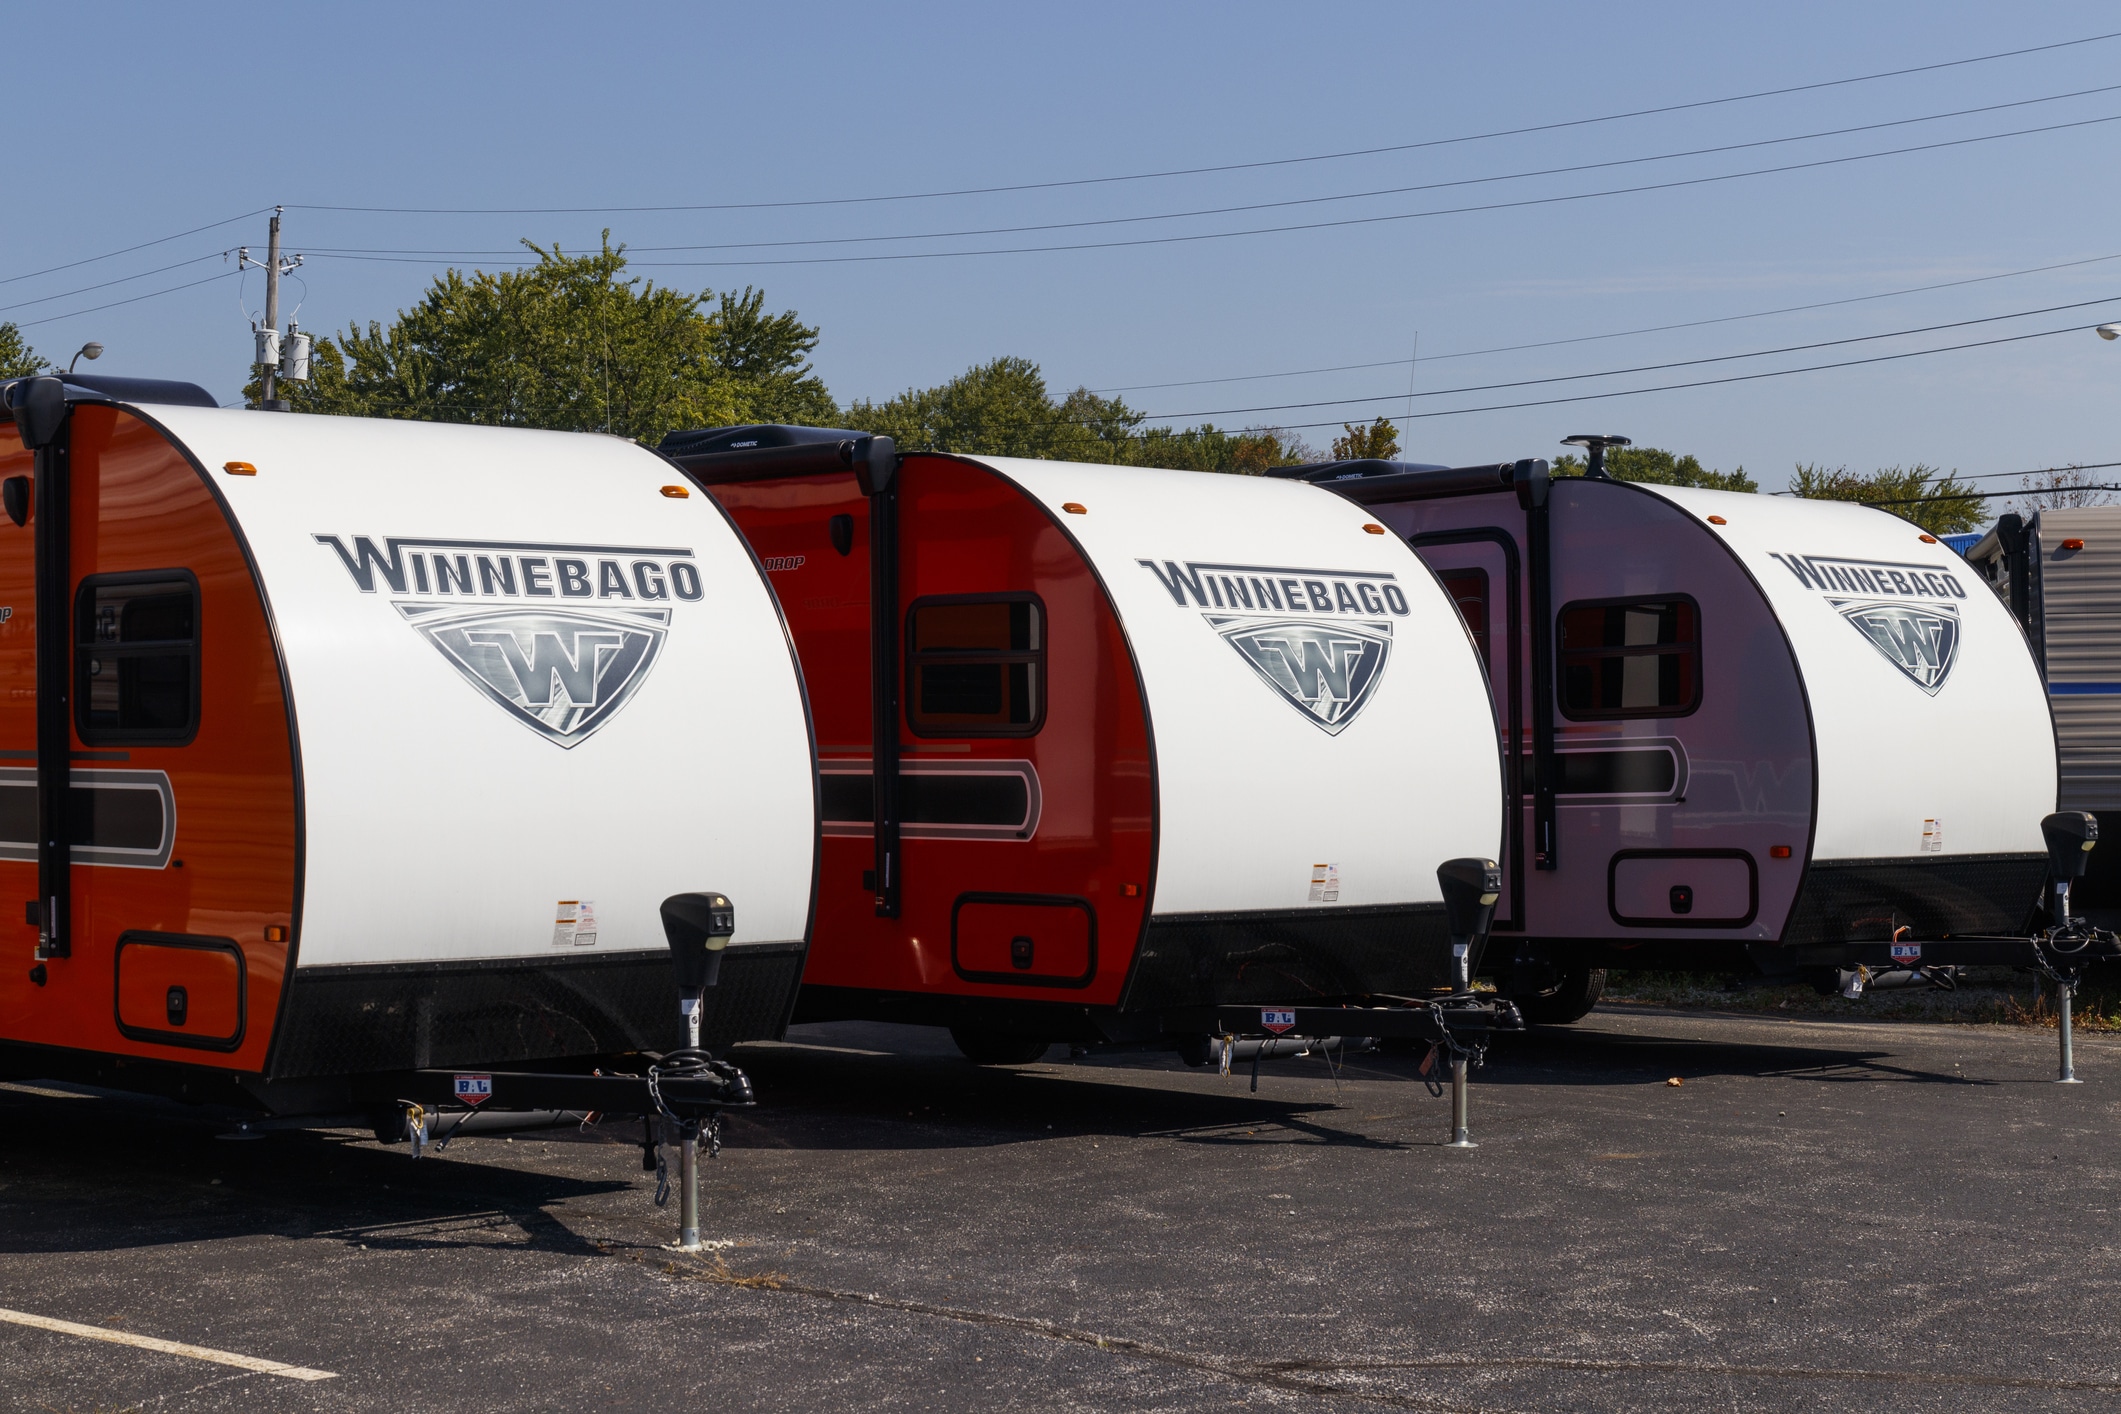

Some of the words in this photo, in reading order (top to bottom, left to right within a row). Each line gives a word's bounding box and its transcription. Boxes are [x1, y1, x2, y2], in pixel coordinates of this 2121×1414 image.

[311, 533, 704, 602] WINNEBAGO
[764, 555, 805, 571] DROP
[1134, 558, 1411, 617] WINNEBAGO
[1765, 551, 1968, 600] WINNEBAGO
[461, 628, 625, 708] W
[1251, 636, 1364, 702] W
[1863, 614, 1943, 669] W
[458, 1080, 489, 1093] BAL
